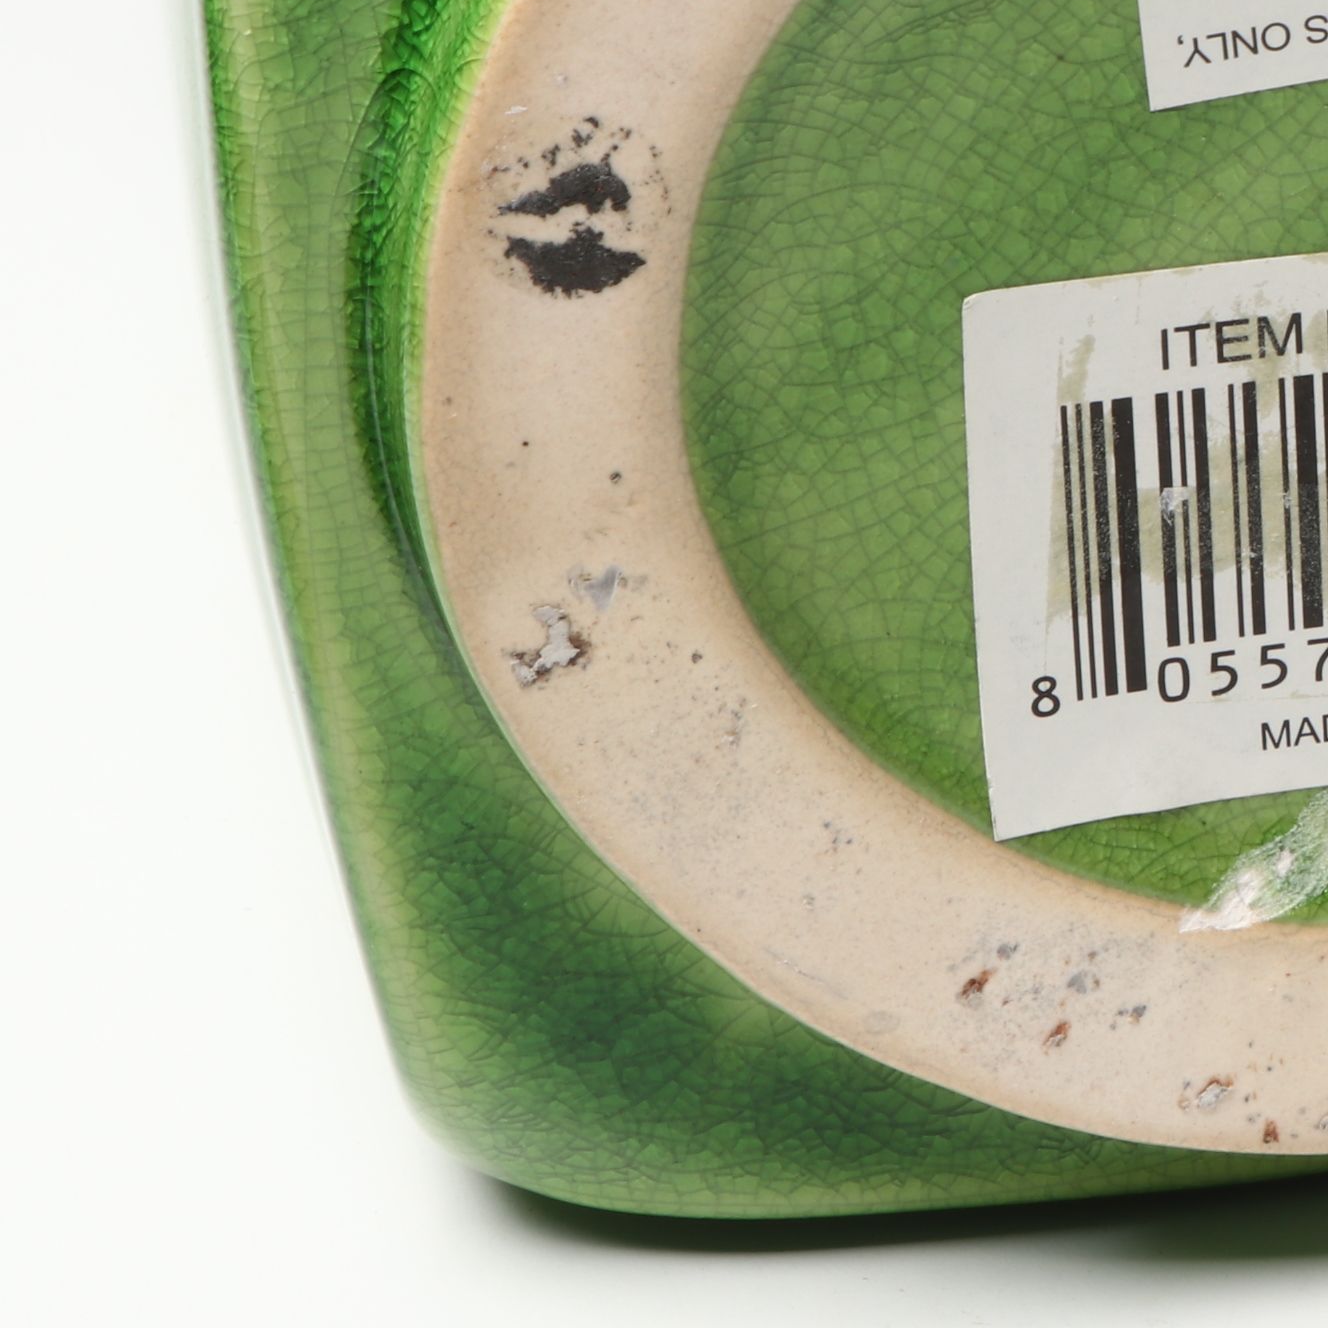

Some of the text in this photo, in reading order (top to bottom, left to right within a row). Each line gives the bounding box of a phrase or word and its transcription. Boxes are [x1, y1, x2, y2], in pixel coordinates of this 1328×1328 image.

[1176, 21, 1292, 68] ONLY,
[1161, 312, 1303, 371] ITEM
[1030, 675, 1061, 718] 8
